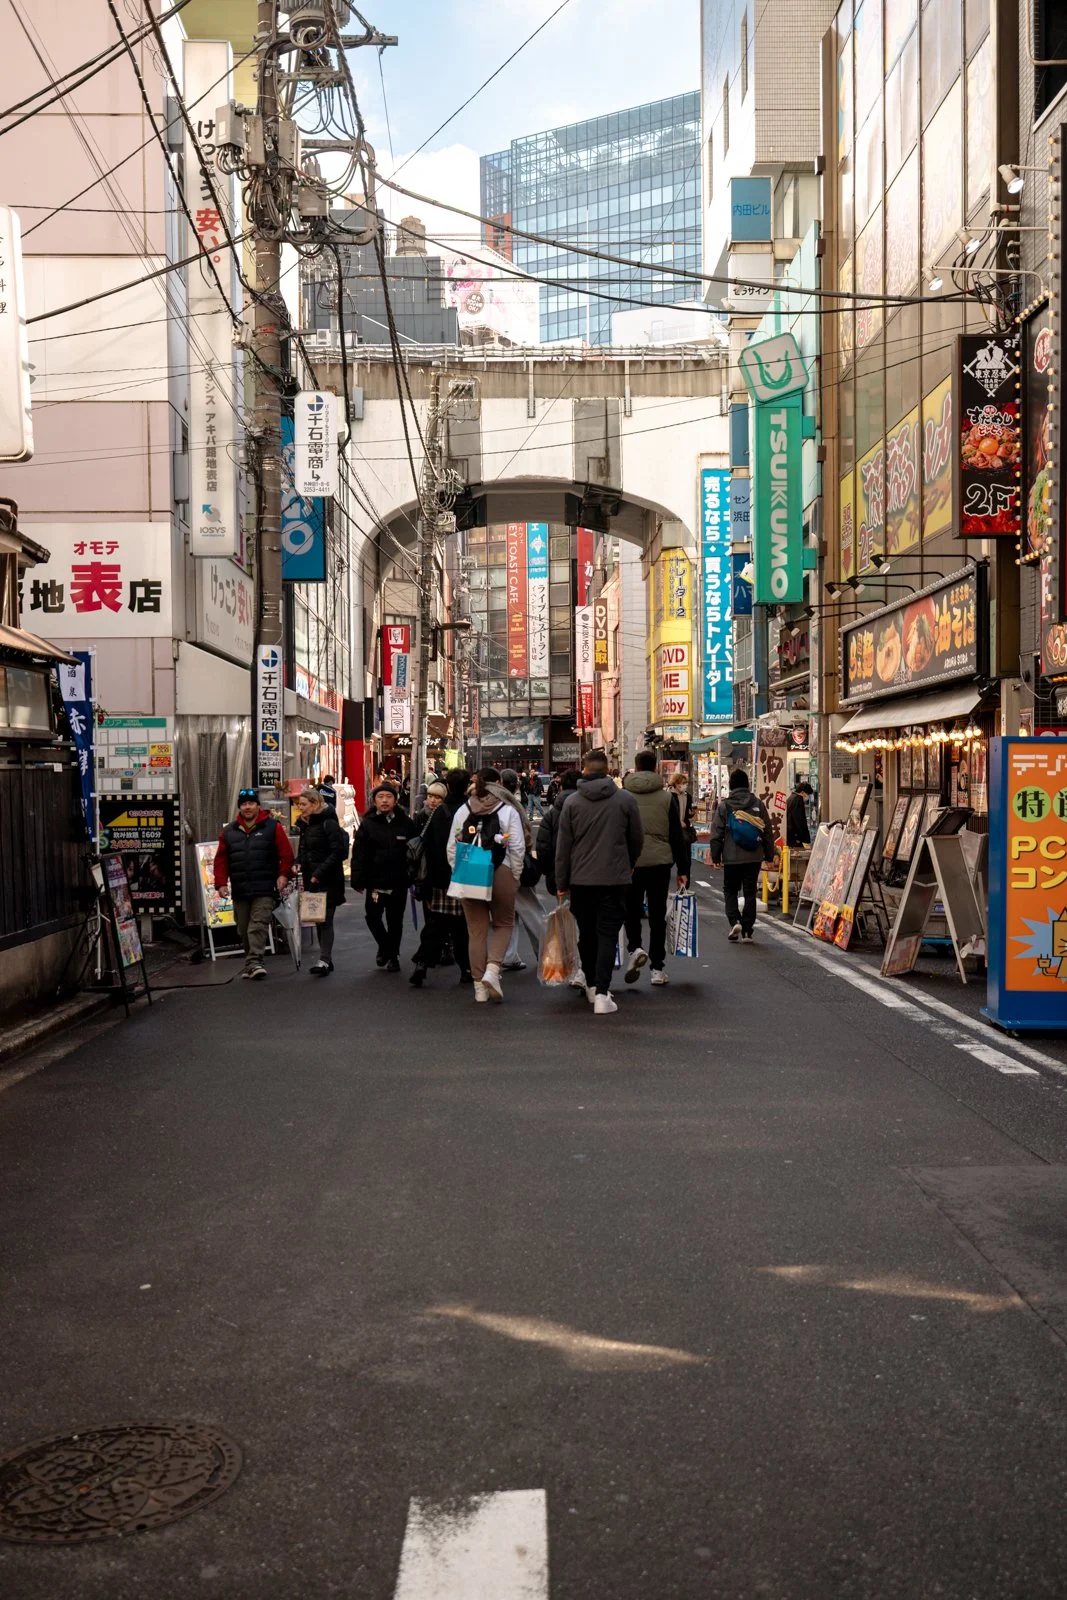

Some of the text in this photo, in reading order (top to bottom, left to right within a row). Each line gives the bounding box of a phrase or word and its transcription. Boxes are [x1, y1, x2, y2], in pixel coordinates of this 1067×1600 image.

[733, 203, 770, 217] 内田ビル
[1004, 339, 1018, 348] 3F
[206, 412, 218, 492] アキバ路地表店
[308, 413, 324, 469] 千石電商
[770, 408, 789, 599] TSUKUMO
[964, 483, 1016, 517] 2F
[74, 541, 119, 555] オモテ
[200, 526, 226, 534] IOSYS
[509, 540, 518, 576] TOAST
[18, 562, 162, 614] 地表店
[510, 579, 519, 603] CAFE
[676, 557, 686, 616] トレーダー2
[537, 585, 547, 660] ライブレストラン
[595, 605, 607, 664] DVD買取
[262, 671, 278, 732] 千石電商
[1012, 754, 1067, 776] デジ
[1011, 836, 1067, 860] PC
[676, 906, 689, 953] TRADER
